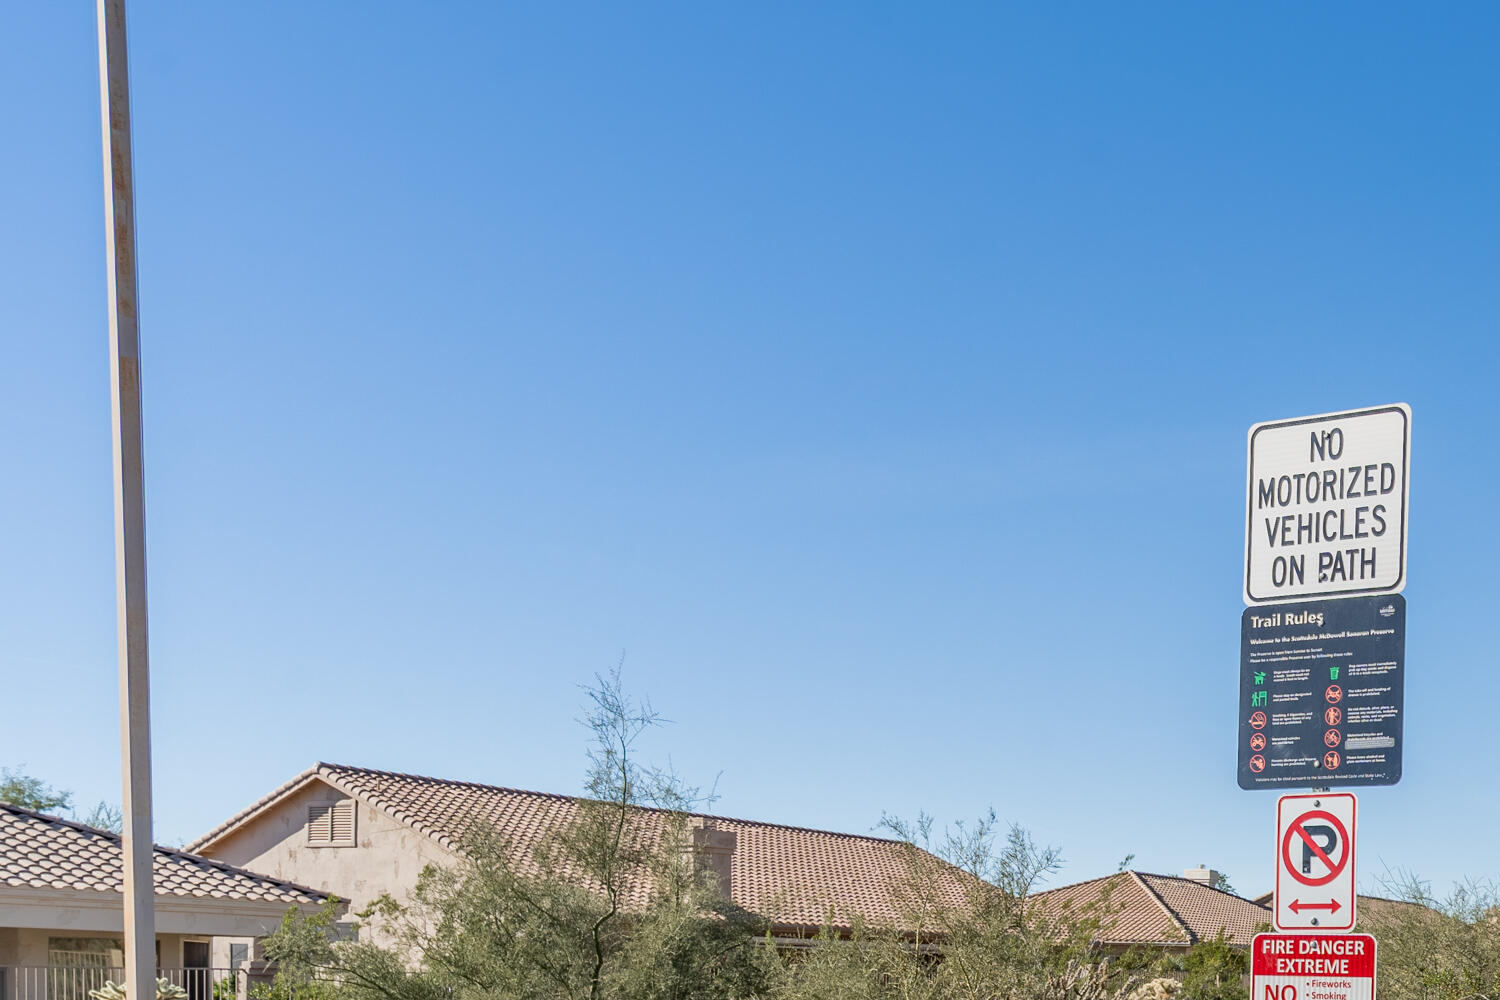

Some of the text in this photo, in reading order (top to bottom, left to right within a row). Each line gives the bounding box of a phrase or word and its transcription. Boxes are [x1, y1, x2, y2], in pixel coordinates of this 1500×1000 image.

[1310, 427, 1344, 463] NO
[1258, 462, 1396, 509] MOTORIZED
[1265, 504, 1387, 548] VEHICLES
[1272, 547, 1377, 588] ON PATH
[1250, 610, 1324, 629] Trail Rules
[1262, 940, 1365, 955] FIRE DANGER
[1277, 959, 1349, 974] EXTREME
[1311, 980, 1351, 988] Fireworks
[1311, 992, 1347, 1000] Smoking
